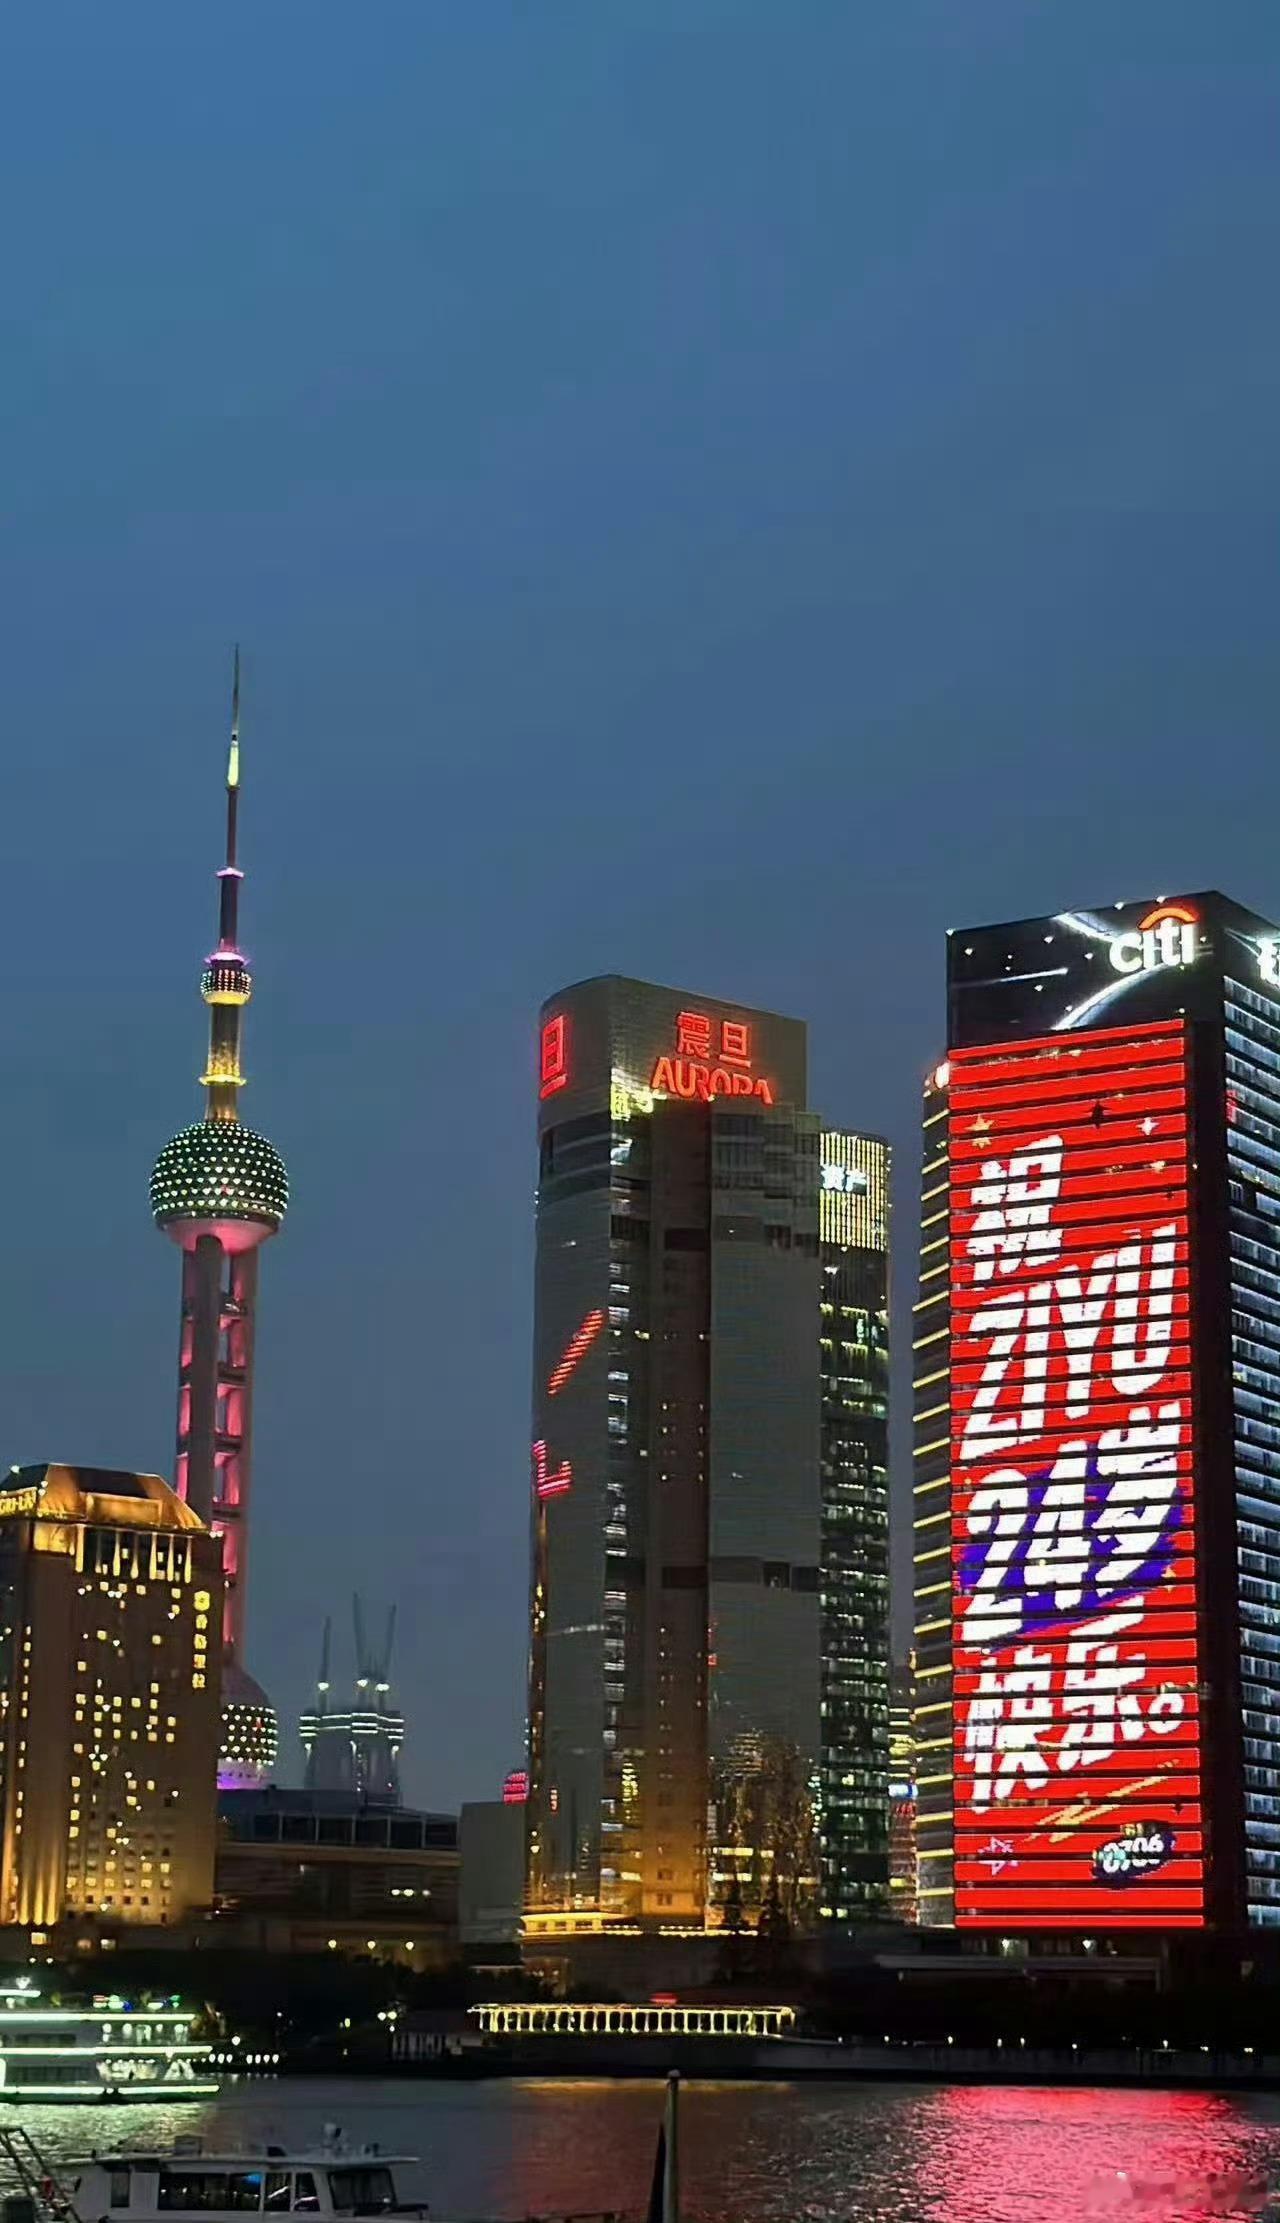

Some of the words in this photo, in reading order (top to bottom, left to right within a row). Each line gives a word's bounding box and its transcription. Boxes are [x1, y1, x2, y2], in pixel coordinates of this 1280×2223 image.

[1109, 908, 1196, 972] citi
[675, 1009, 752, 1068] 震旦
[959, 1222, 1177, 1461] ZIYU
[1103, 1833, 1165, 1874] 0706
